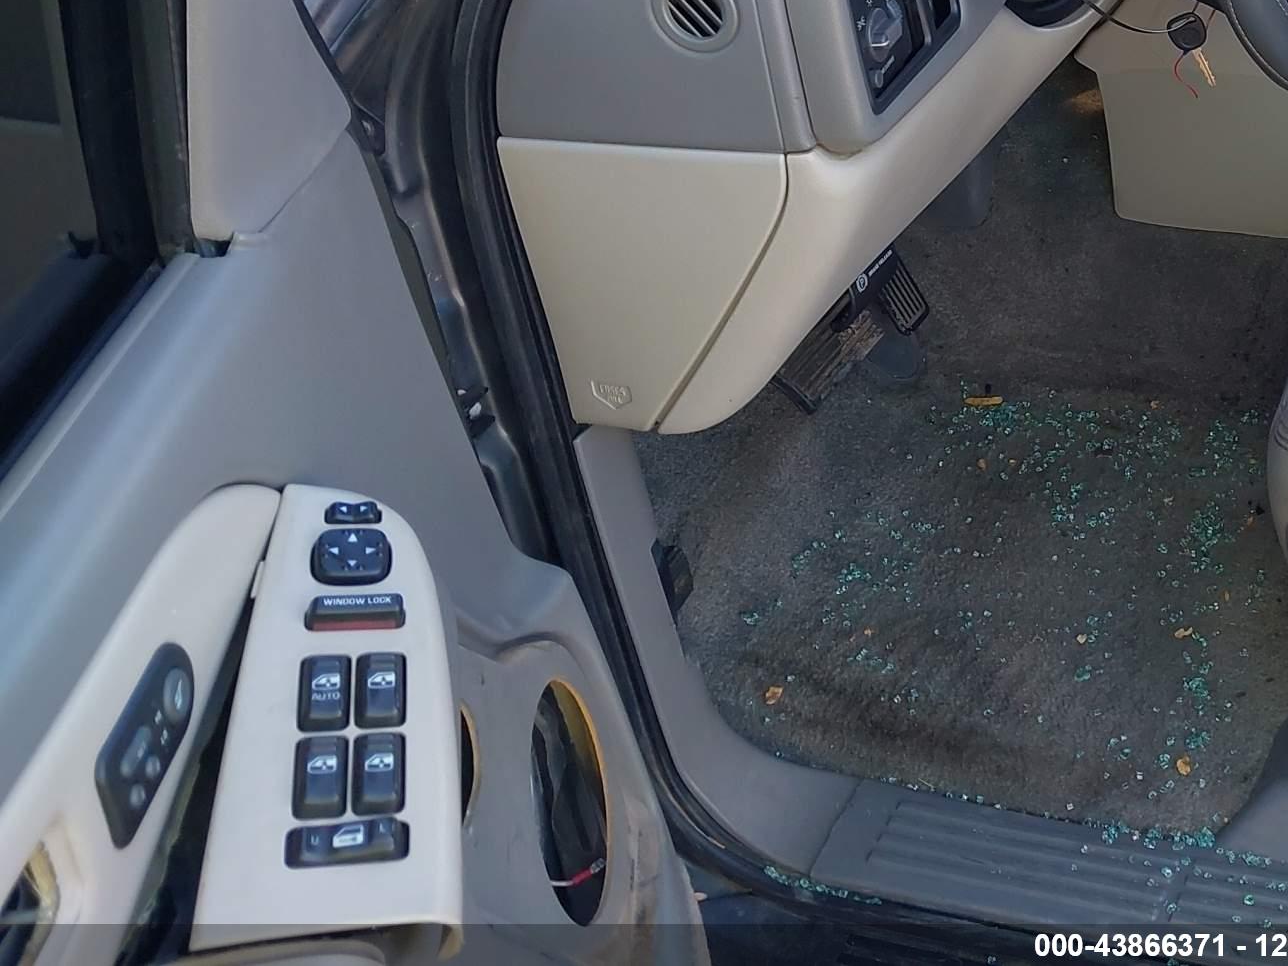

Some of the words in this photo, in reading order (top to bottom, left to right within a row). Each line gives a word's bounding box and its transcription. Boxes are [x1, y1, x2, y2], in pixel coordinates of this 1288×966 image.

[323, 596, 366, 607] WINDOW
[367, 595, 393, 605] LOCK
[311, 690, 341, 701] AUTO
